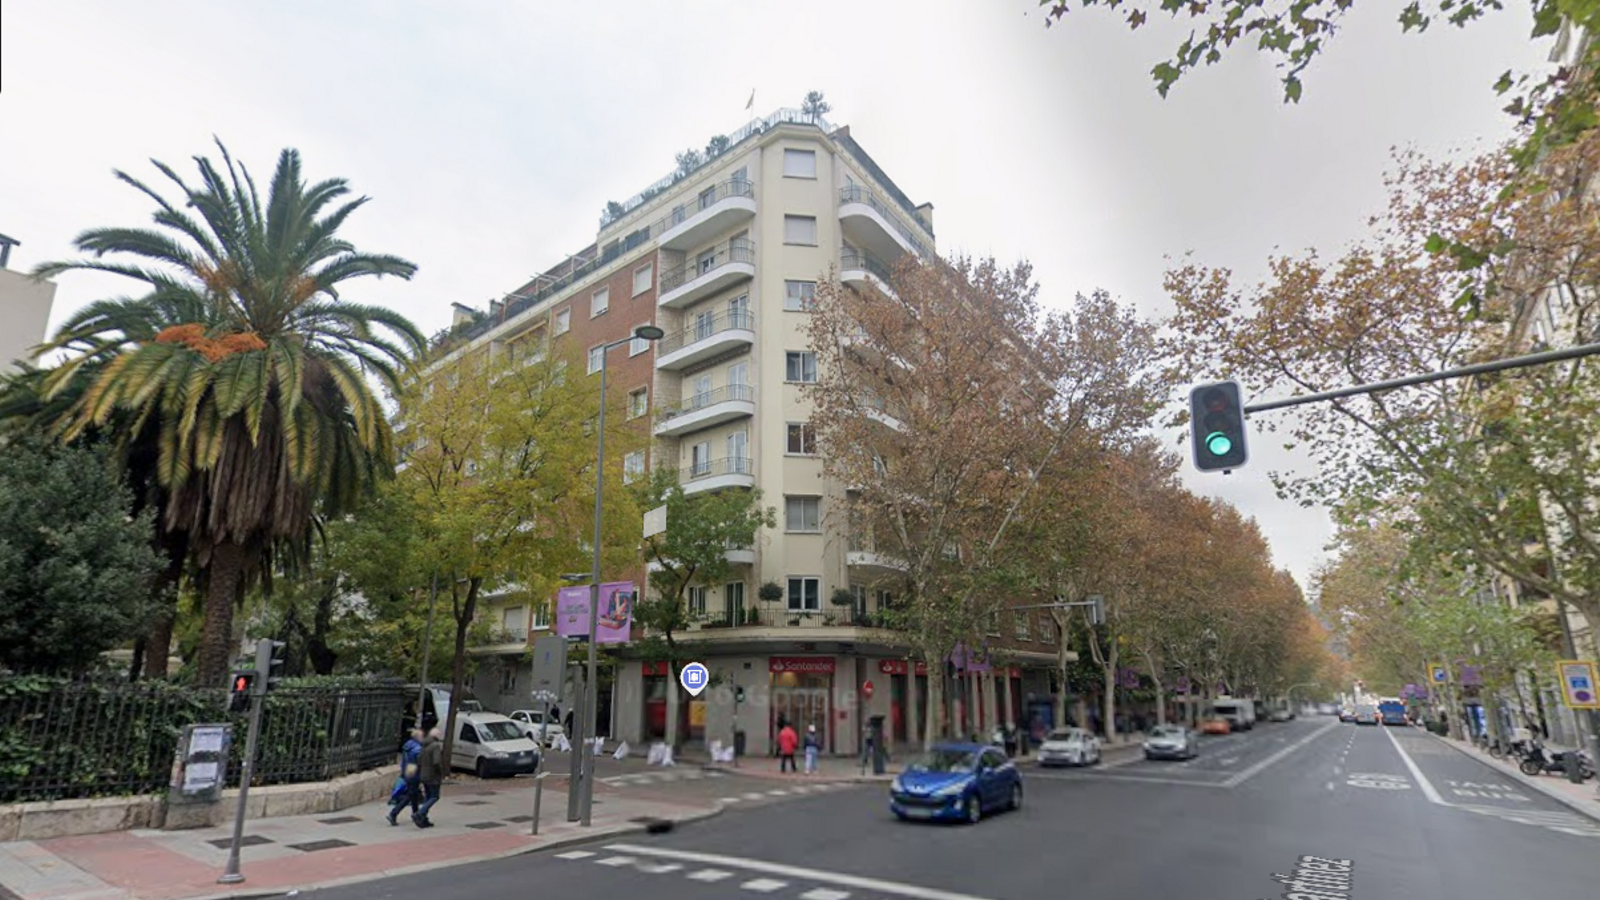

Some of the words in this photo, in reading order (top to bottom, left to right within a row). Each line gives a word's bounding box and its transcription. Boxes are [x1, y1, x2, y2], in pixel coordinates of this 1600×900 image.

[785, 660, 833, 671] Santander
[1445, 779, 1513, 792] TAXI
[1452, 788, 1532, 801] BUS
